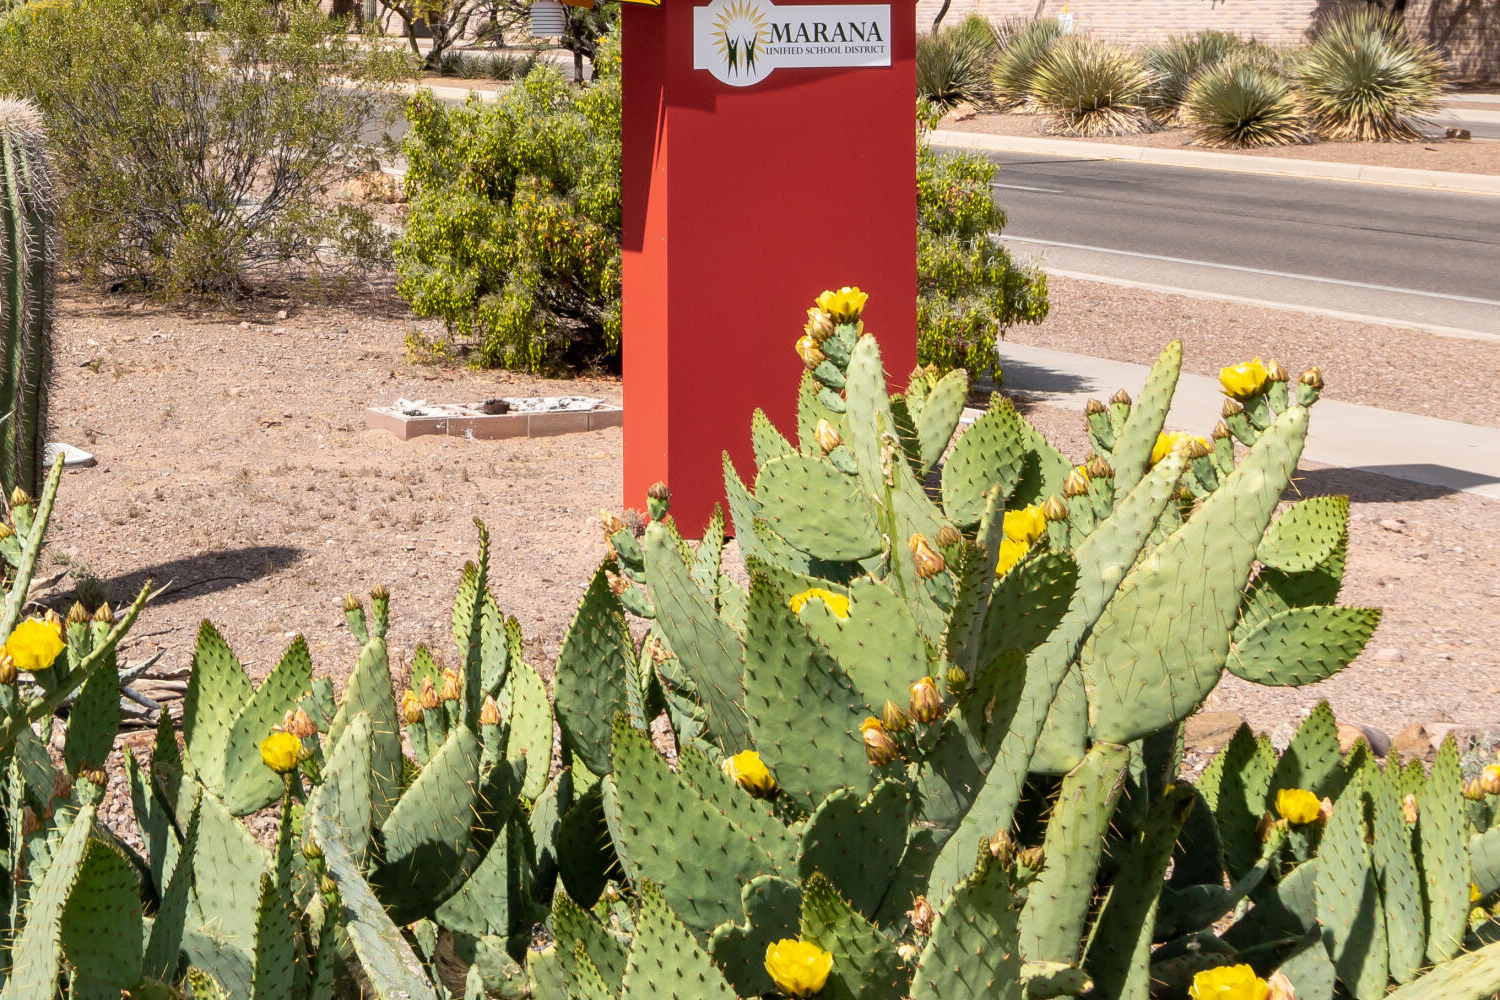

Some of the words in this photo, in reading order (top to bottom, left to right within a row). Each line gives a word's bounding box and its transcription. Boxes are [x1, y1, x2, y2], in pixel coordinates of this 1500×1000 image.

[768, 20, 884, 45] MARANA
[765, 45, 804, 56] UNIFIED
[805, 45, 843, 55] SCHOOL
[844, 44, 886, 55] DISTRICT
